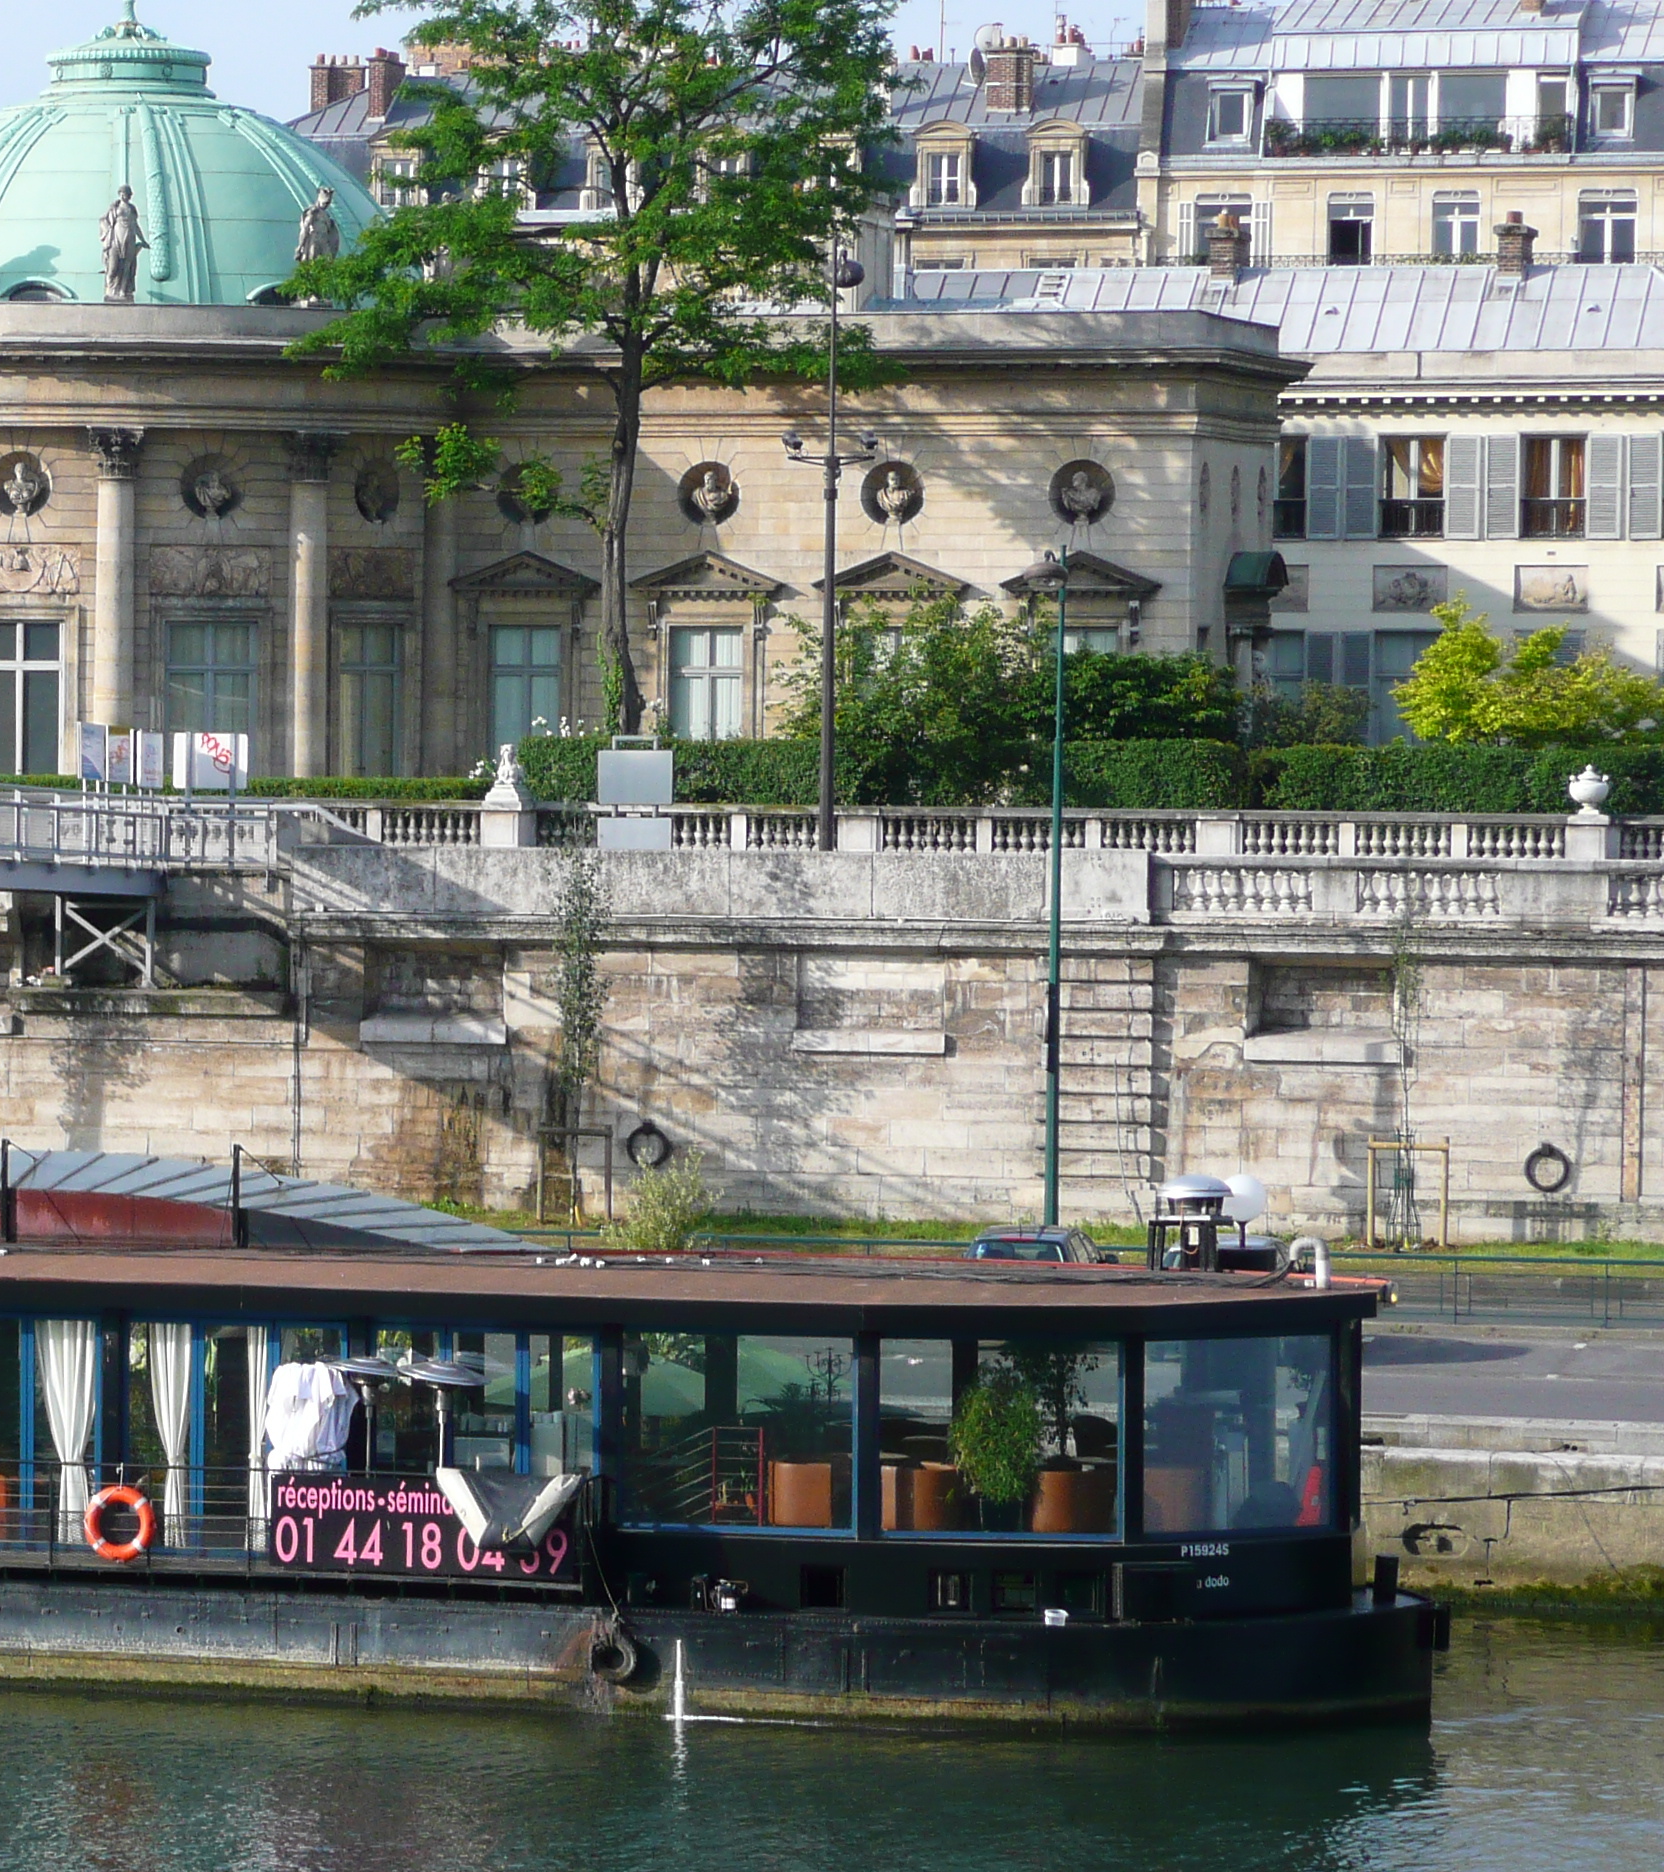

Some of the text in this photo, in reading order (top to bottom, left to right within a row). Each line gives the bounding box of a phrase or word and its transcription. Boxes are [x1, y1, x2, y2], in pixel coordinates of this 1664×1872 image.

[277, 1476, 375, 1519] réceptions
[275, 1515, 314, 1563] 01
[333, 1517, 383, 1566] 44
[401, 1521, 442, 1570] 18
